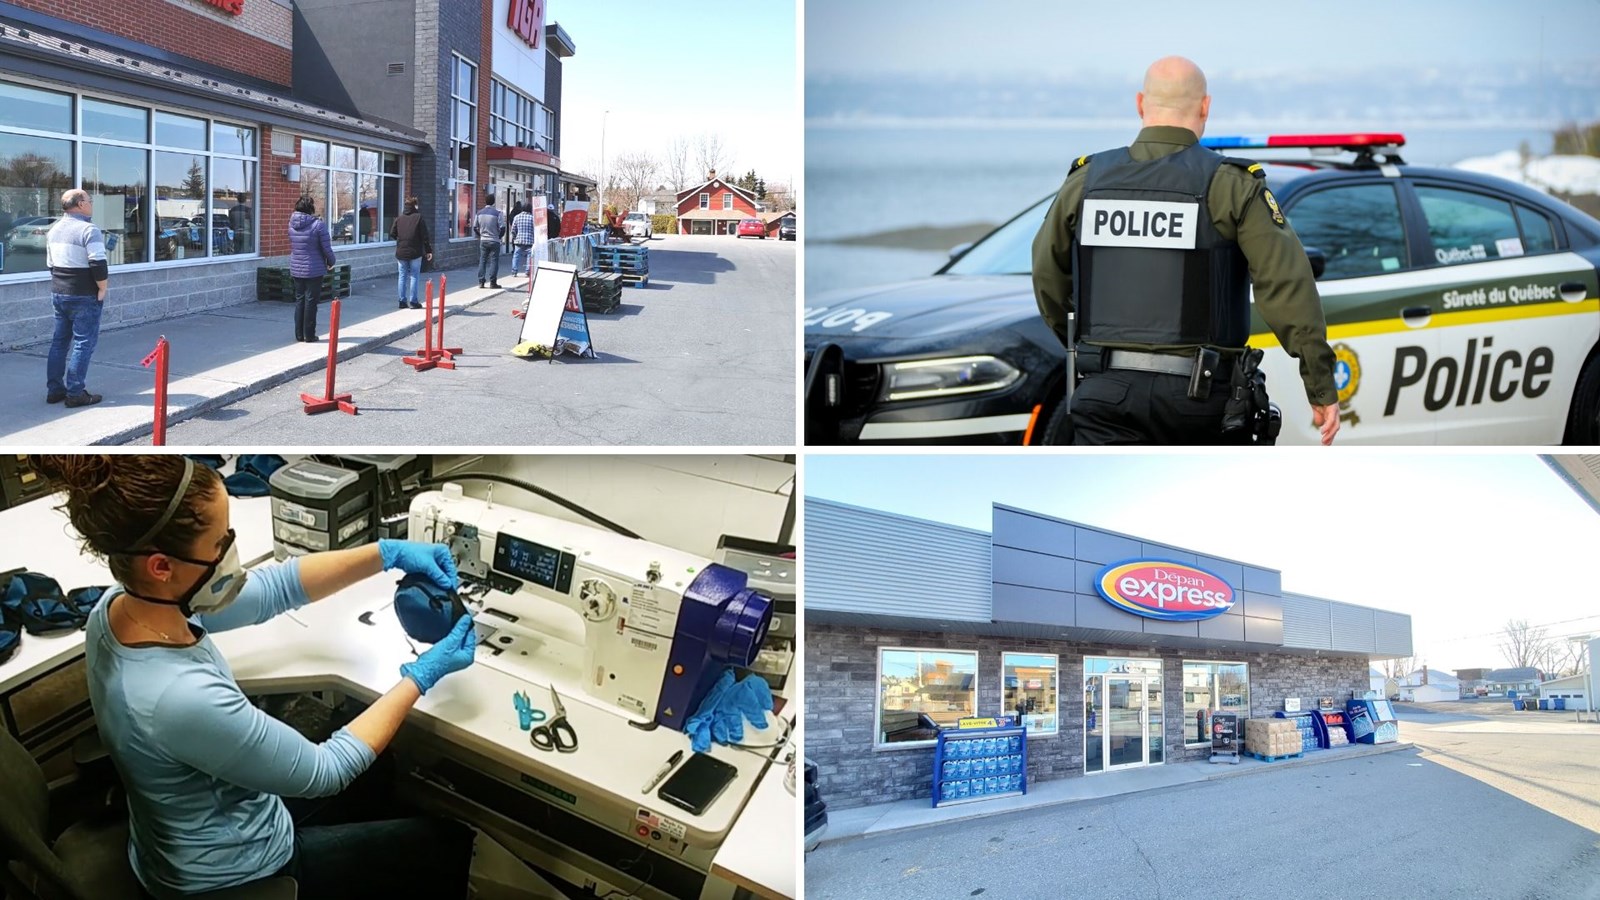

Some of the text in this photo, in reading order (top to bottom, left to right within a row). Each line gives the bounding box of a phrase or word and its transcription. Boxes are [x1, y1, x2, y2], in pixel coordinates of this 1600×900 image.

[507, 0, 544, 49] IGA
[1093, 209, 1185, 238] POLICE
[1435, 247, 1472, 264] Québec
[1442, 284, 1556, 309] Sûreté du Québec
[1383, 336, 1555, 417] Police
[1154, 568, 1205, 587] Dépan
[1119, 577, 1227, 608] express
